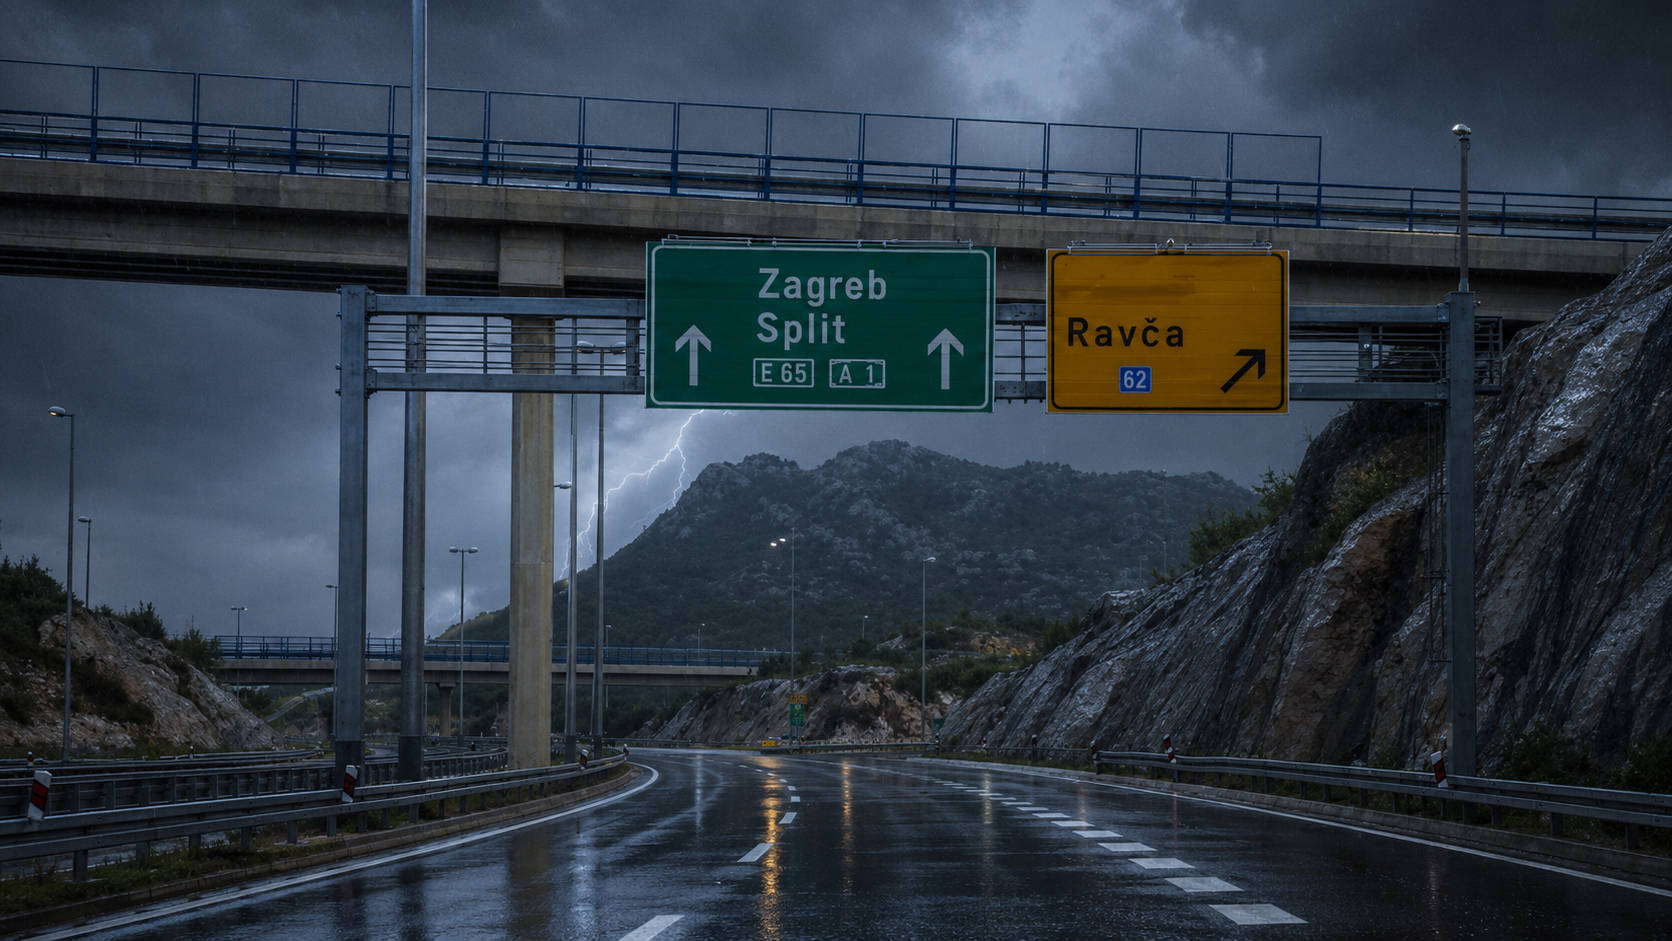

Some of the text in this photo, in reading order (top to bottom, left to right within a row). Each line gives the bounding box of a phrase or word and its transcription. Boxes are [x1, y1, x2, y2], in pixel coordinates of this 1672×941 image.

[758, 267, 887, 307] Zagreb
[756, 312, 846, 351] Split
[1067, 317, 1184, 347] Ravča
[761, 362, 807, 384] E 65
[838, 363, 874, 384] A 1
[1124, 370, 1147, 389] 62
